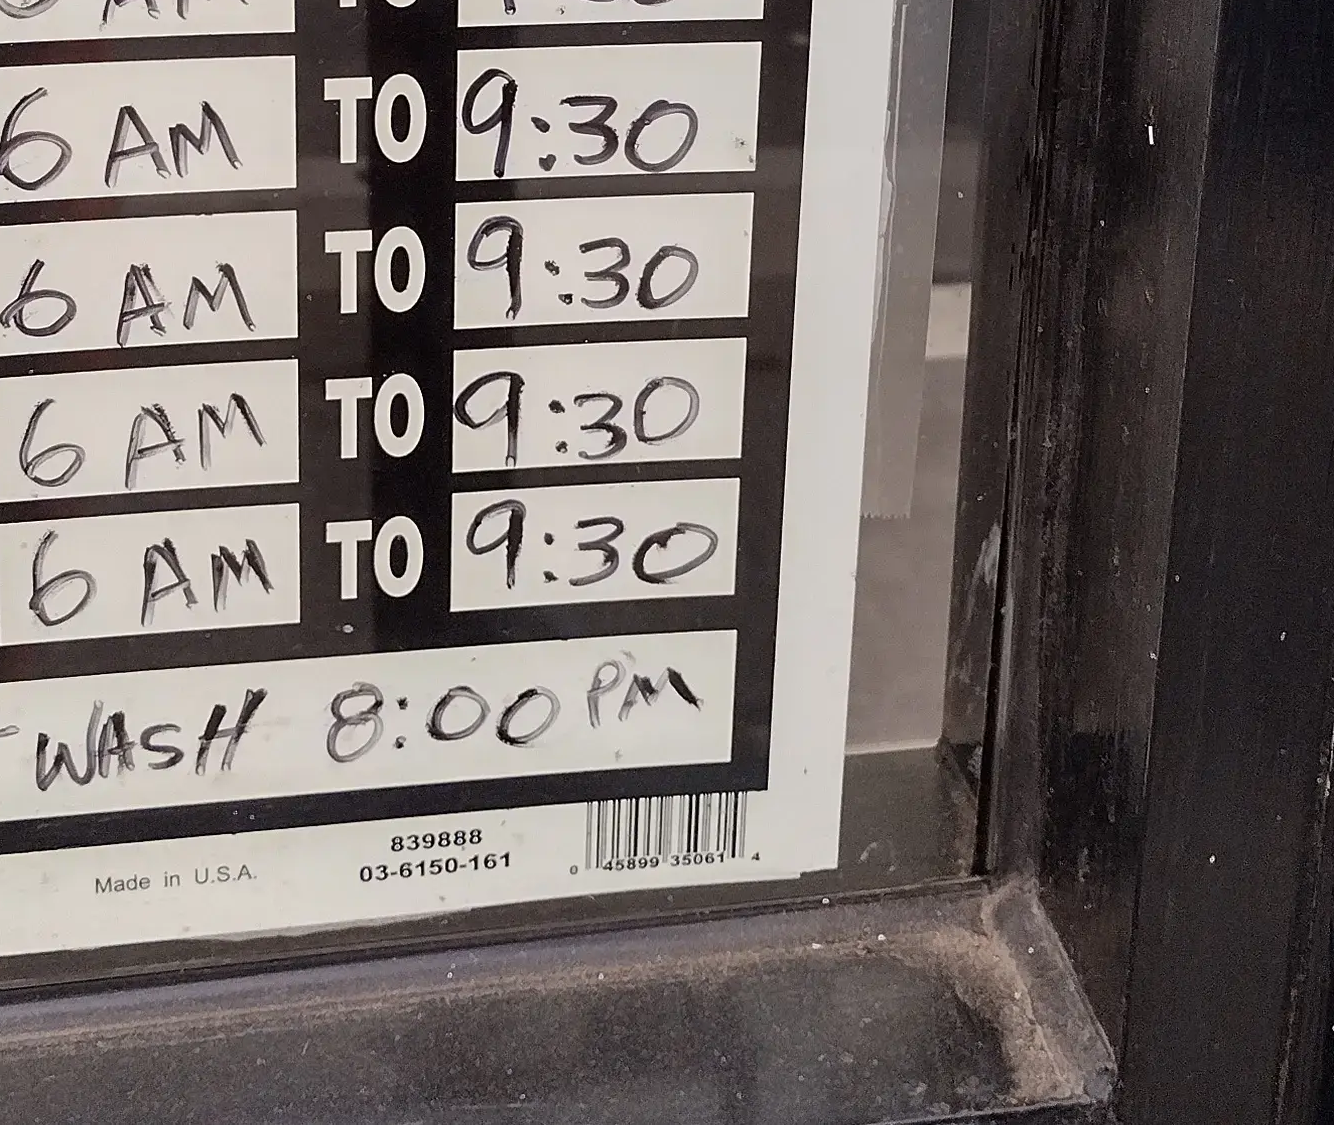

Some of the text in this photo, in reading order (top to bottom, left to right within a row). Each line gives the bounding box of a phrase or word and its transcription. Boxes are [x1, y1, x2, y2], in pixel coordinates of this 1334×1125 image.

[104, 100, 244, 188] AM
[324, 73, 427, 164] TO
[462, 68, 699, 179] 9:30
[0, 258, 78, 338] 6
[116, 261, 256, 348] AM
[325, 225, 426, 314] TO
[467, 215, 699, 321] 9:30
[19, 397, 86, 489] 6
[124, 392, 266, 491] AM
[325, 373, 425, 459] TO
[454, 371, 700, 468] 9:30
[30, 530, 97, 627] 6
[141, 537, 273, 628] AM
[326, 516, 424, 600] TO
[466, 499, 719, 590] 9:30
[33, 687, 267, 793] WASH
[325, 681, 562, 763] 8:00
[586, 658, 704, 729] PM
[95, 864, 258, 895] Made in U.S.A.
[359, 852, 513, 884] 03-6150-161
[390, 828, 483, 853] 839888
[569, 851, 761, 876] 0 45899 35061 4
